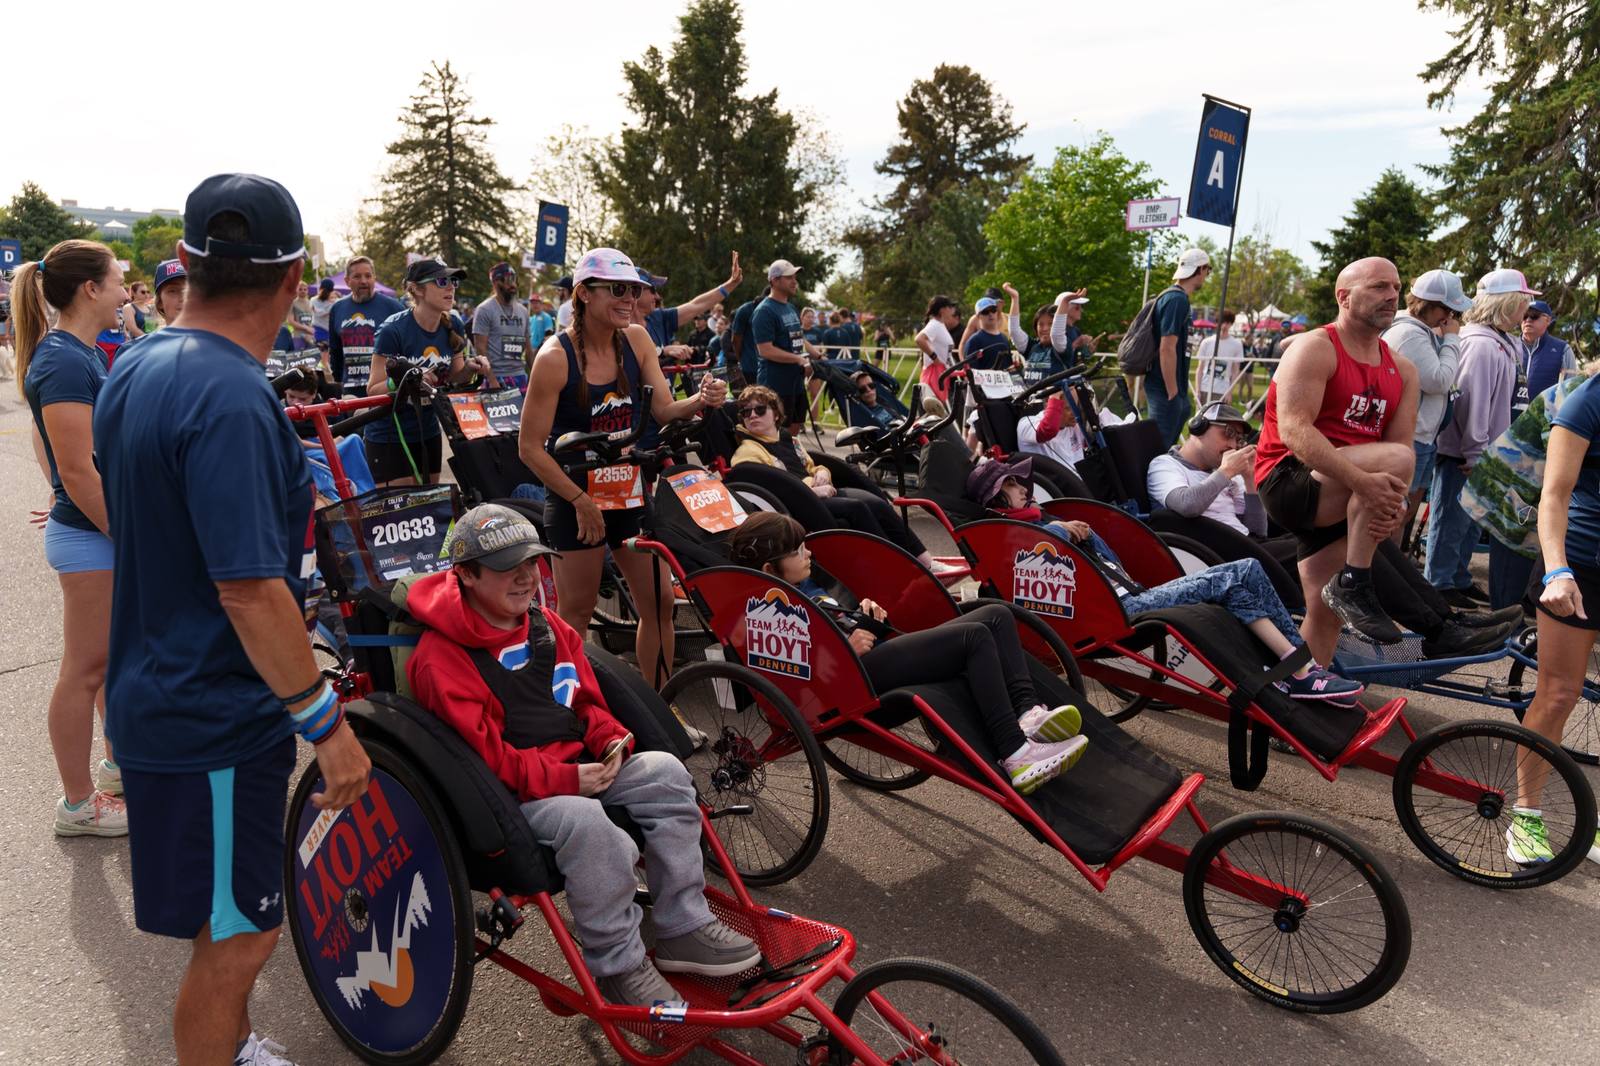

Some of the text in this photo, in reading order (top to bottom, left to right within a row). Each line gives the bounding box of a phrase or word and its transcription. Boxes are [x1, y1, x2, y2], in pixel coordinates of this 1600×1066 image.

[1208, 127, 1236, 146] CORRAL
[1207, 150, 1224, 189] A
[1139, 212, 1167, 224] FLETCHER
[545, 225, 557, 246] B
[4, 250, 14, 263] D
[594, 465, 633, 484] 23553
[372, 515, 436, 547] 20633
[1015, 567, 1039, 578] TEAM
[1015, 578, 1075, 604] HOYT
[1024, 600, 1064, 614] DENVER
[747, 618, 772, 631] TEAM
[747, 629, 811, 663] HOYT
[760, 658, 800, 675] DENVER
[306, 808, 338, 852] ENVER
[1286, 820, 1329, 838] CONTACT
[300, 777, 399, 942] HOYT
[362, 835, 414, 898] TEAM
